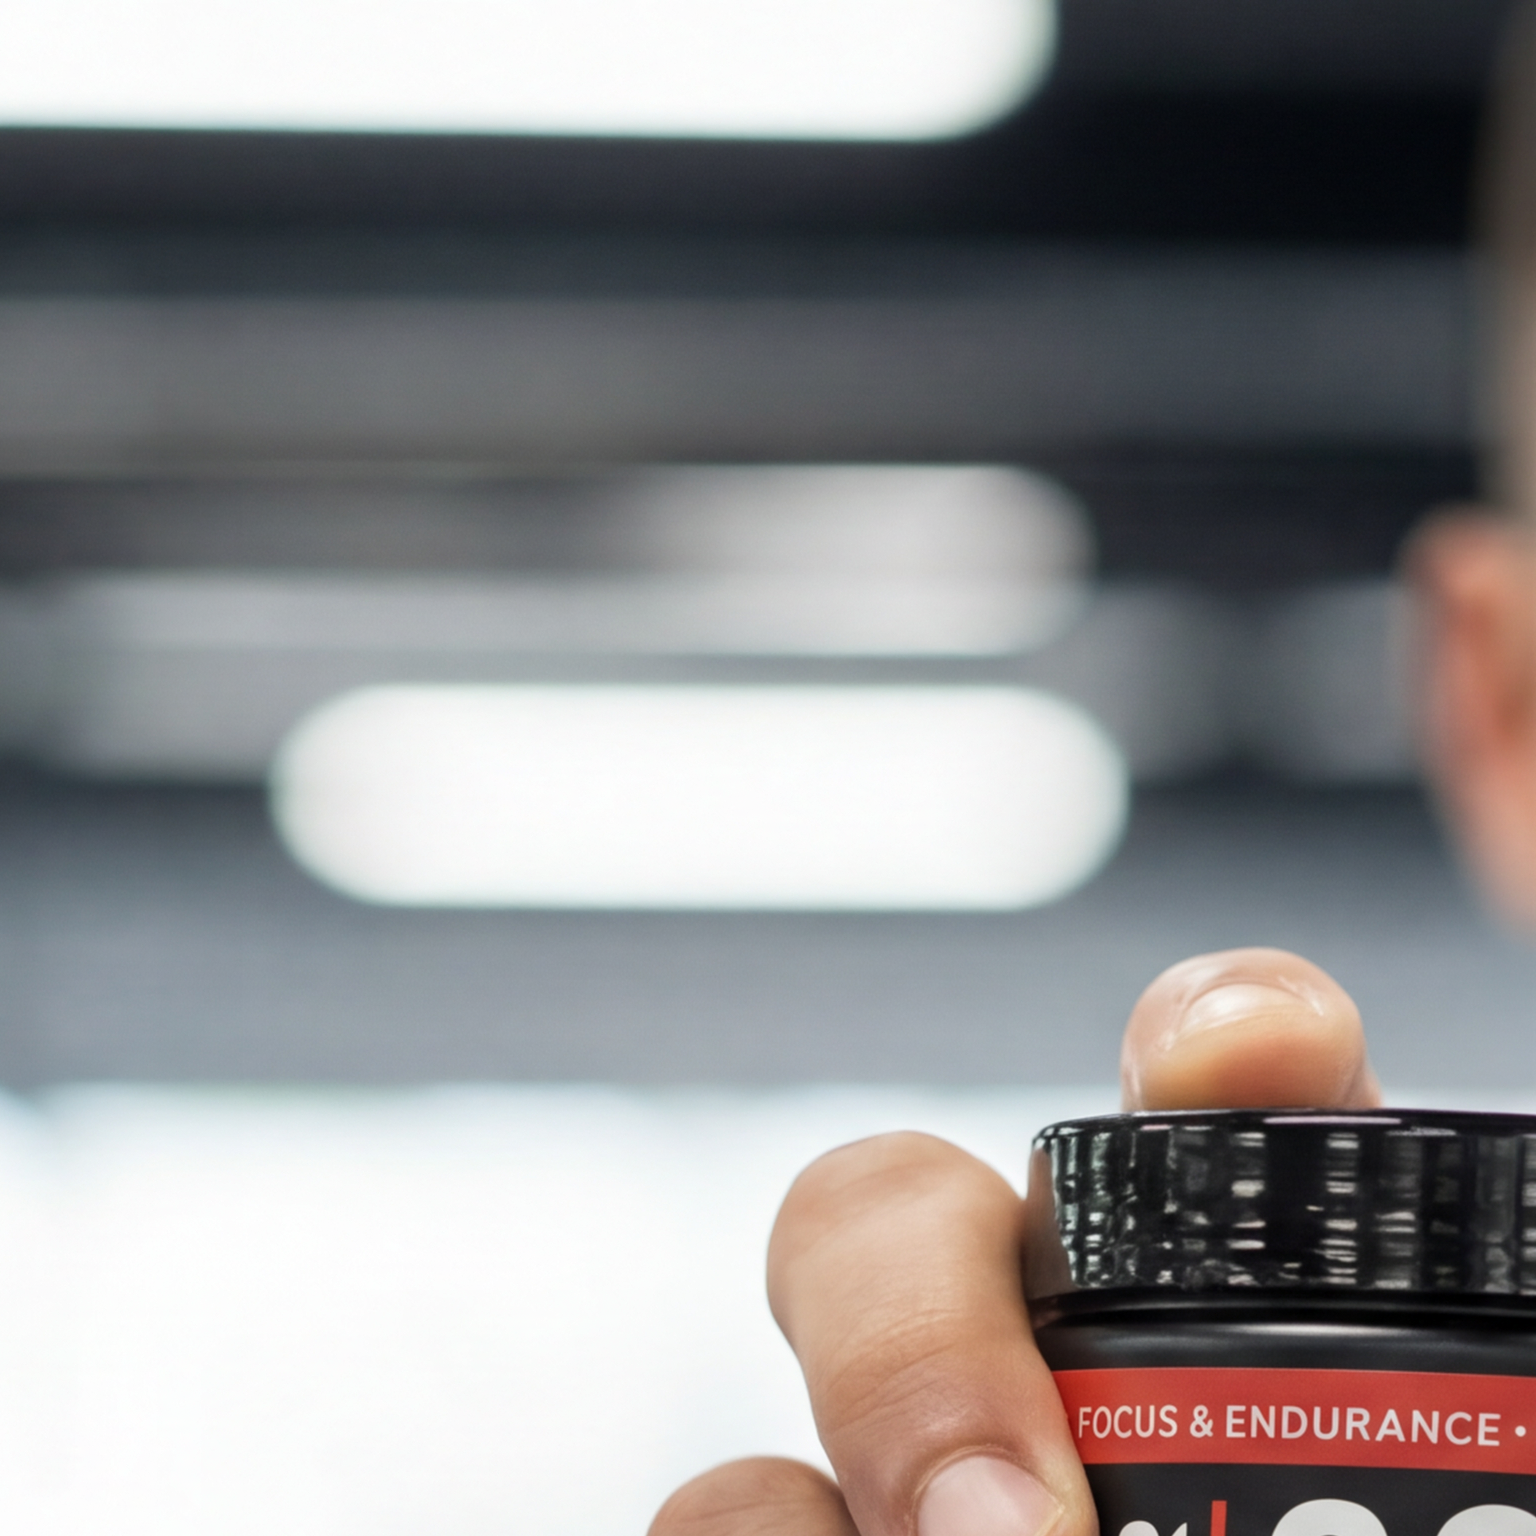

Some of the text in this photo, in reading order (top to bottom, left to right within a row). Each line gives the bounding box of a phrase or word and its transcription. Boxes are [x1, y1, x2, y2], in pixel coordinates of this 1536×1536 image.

[1078, 1404, 1178, 1439] FOCUS
[1189, 1405, 1214, 1438] &
[1225, 1405, 1501, 1447] ENDURANCE
